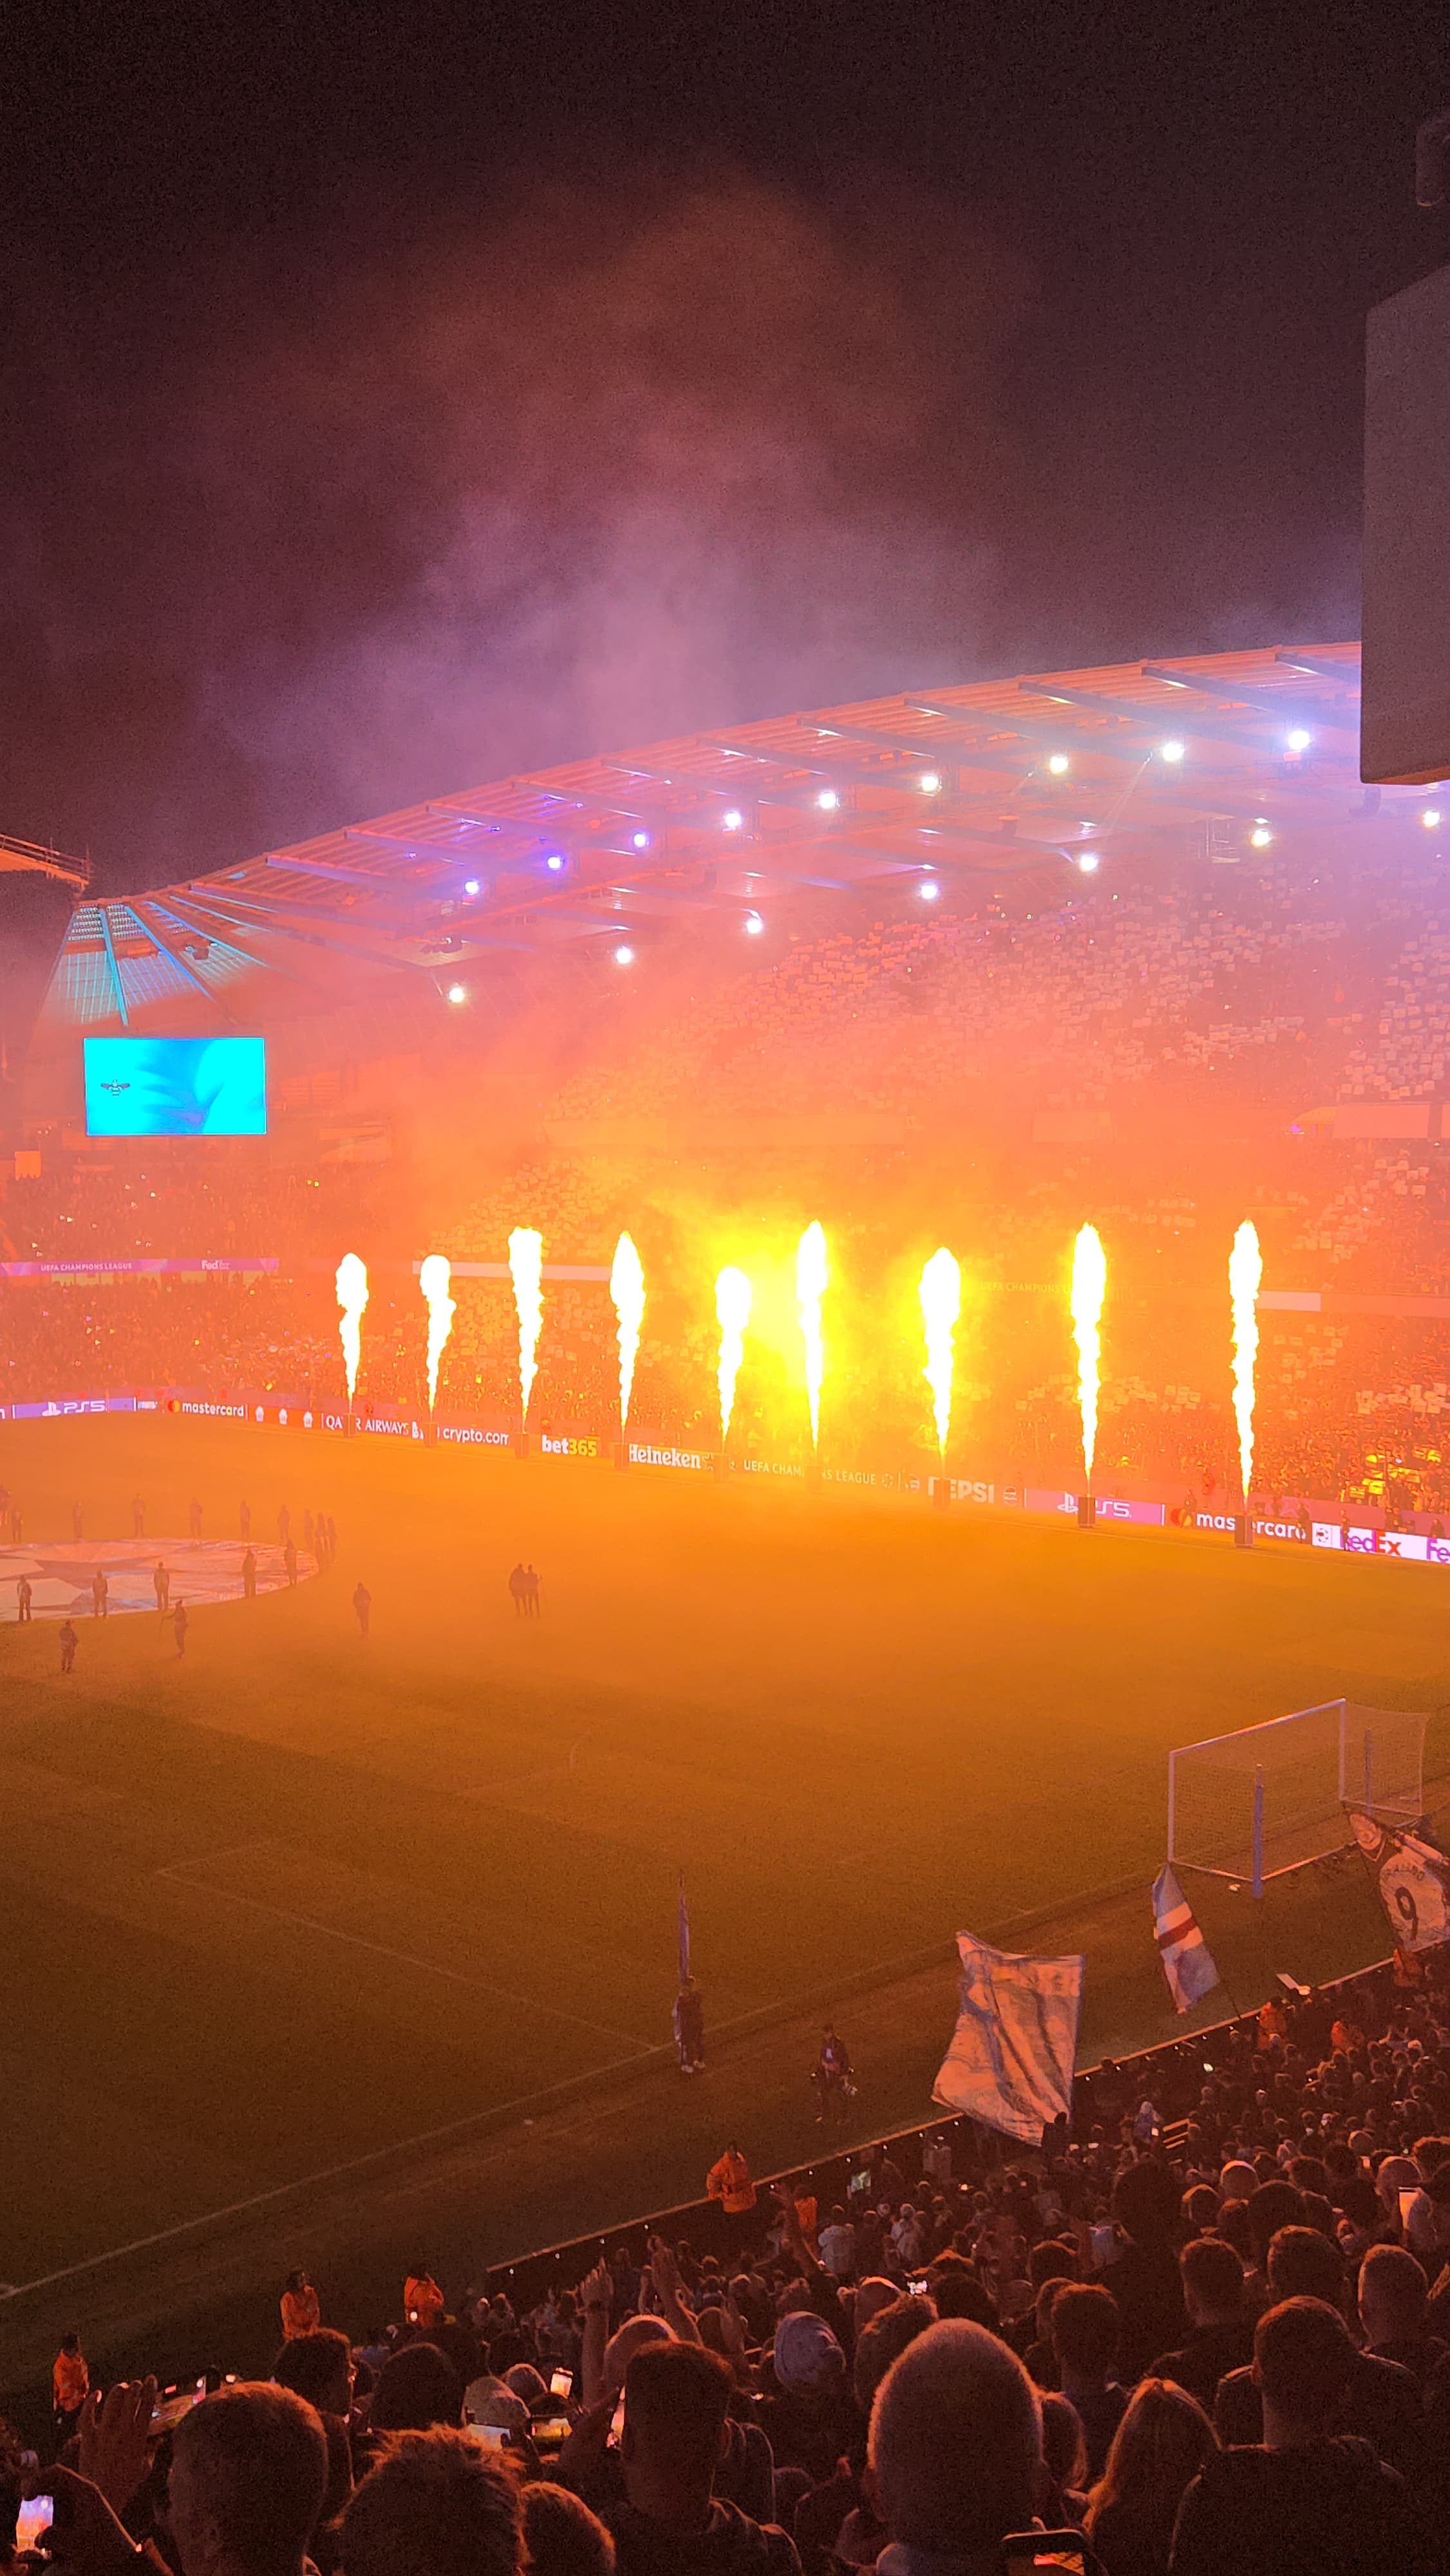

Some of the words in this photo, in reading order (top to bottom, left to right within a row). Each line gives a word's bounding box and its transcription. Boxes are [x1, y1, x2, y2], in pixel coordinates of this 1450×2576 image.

[61, 1263, 104, 1271] CHAMPIONS
[182, 1401, 245, 1417] mastercard
[326, 1414, 361, 1431] QAR
[364, 1419, 409, 1435] AIRWAYS
[541, 1434, 597, 1457] bet365
[629, 1443, 701, 1469] Heineken
[743, 1459, 769, 1473] UEFA
[836, 1470, 876, 1485] LEAGUE
